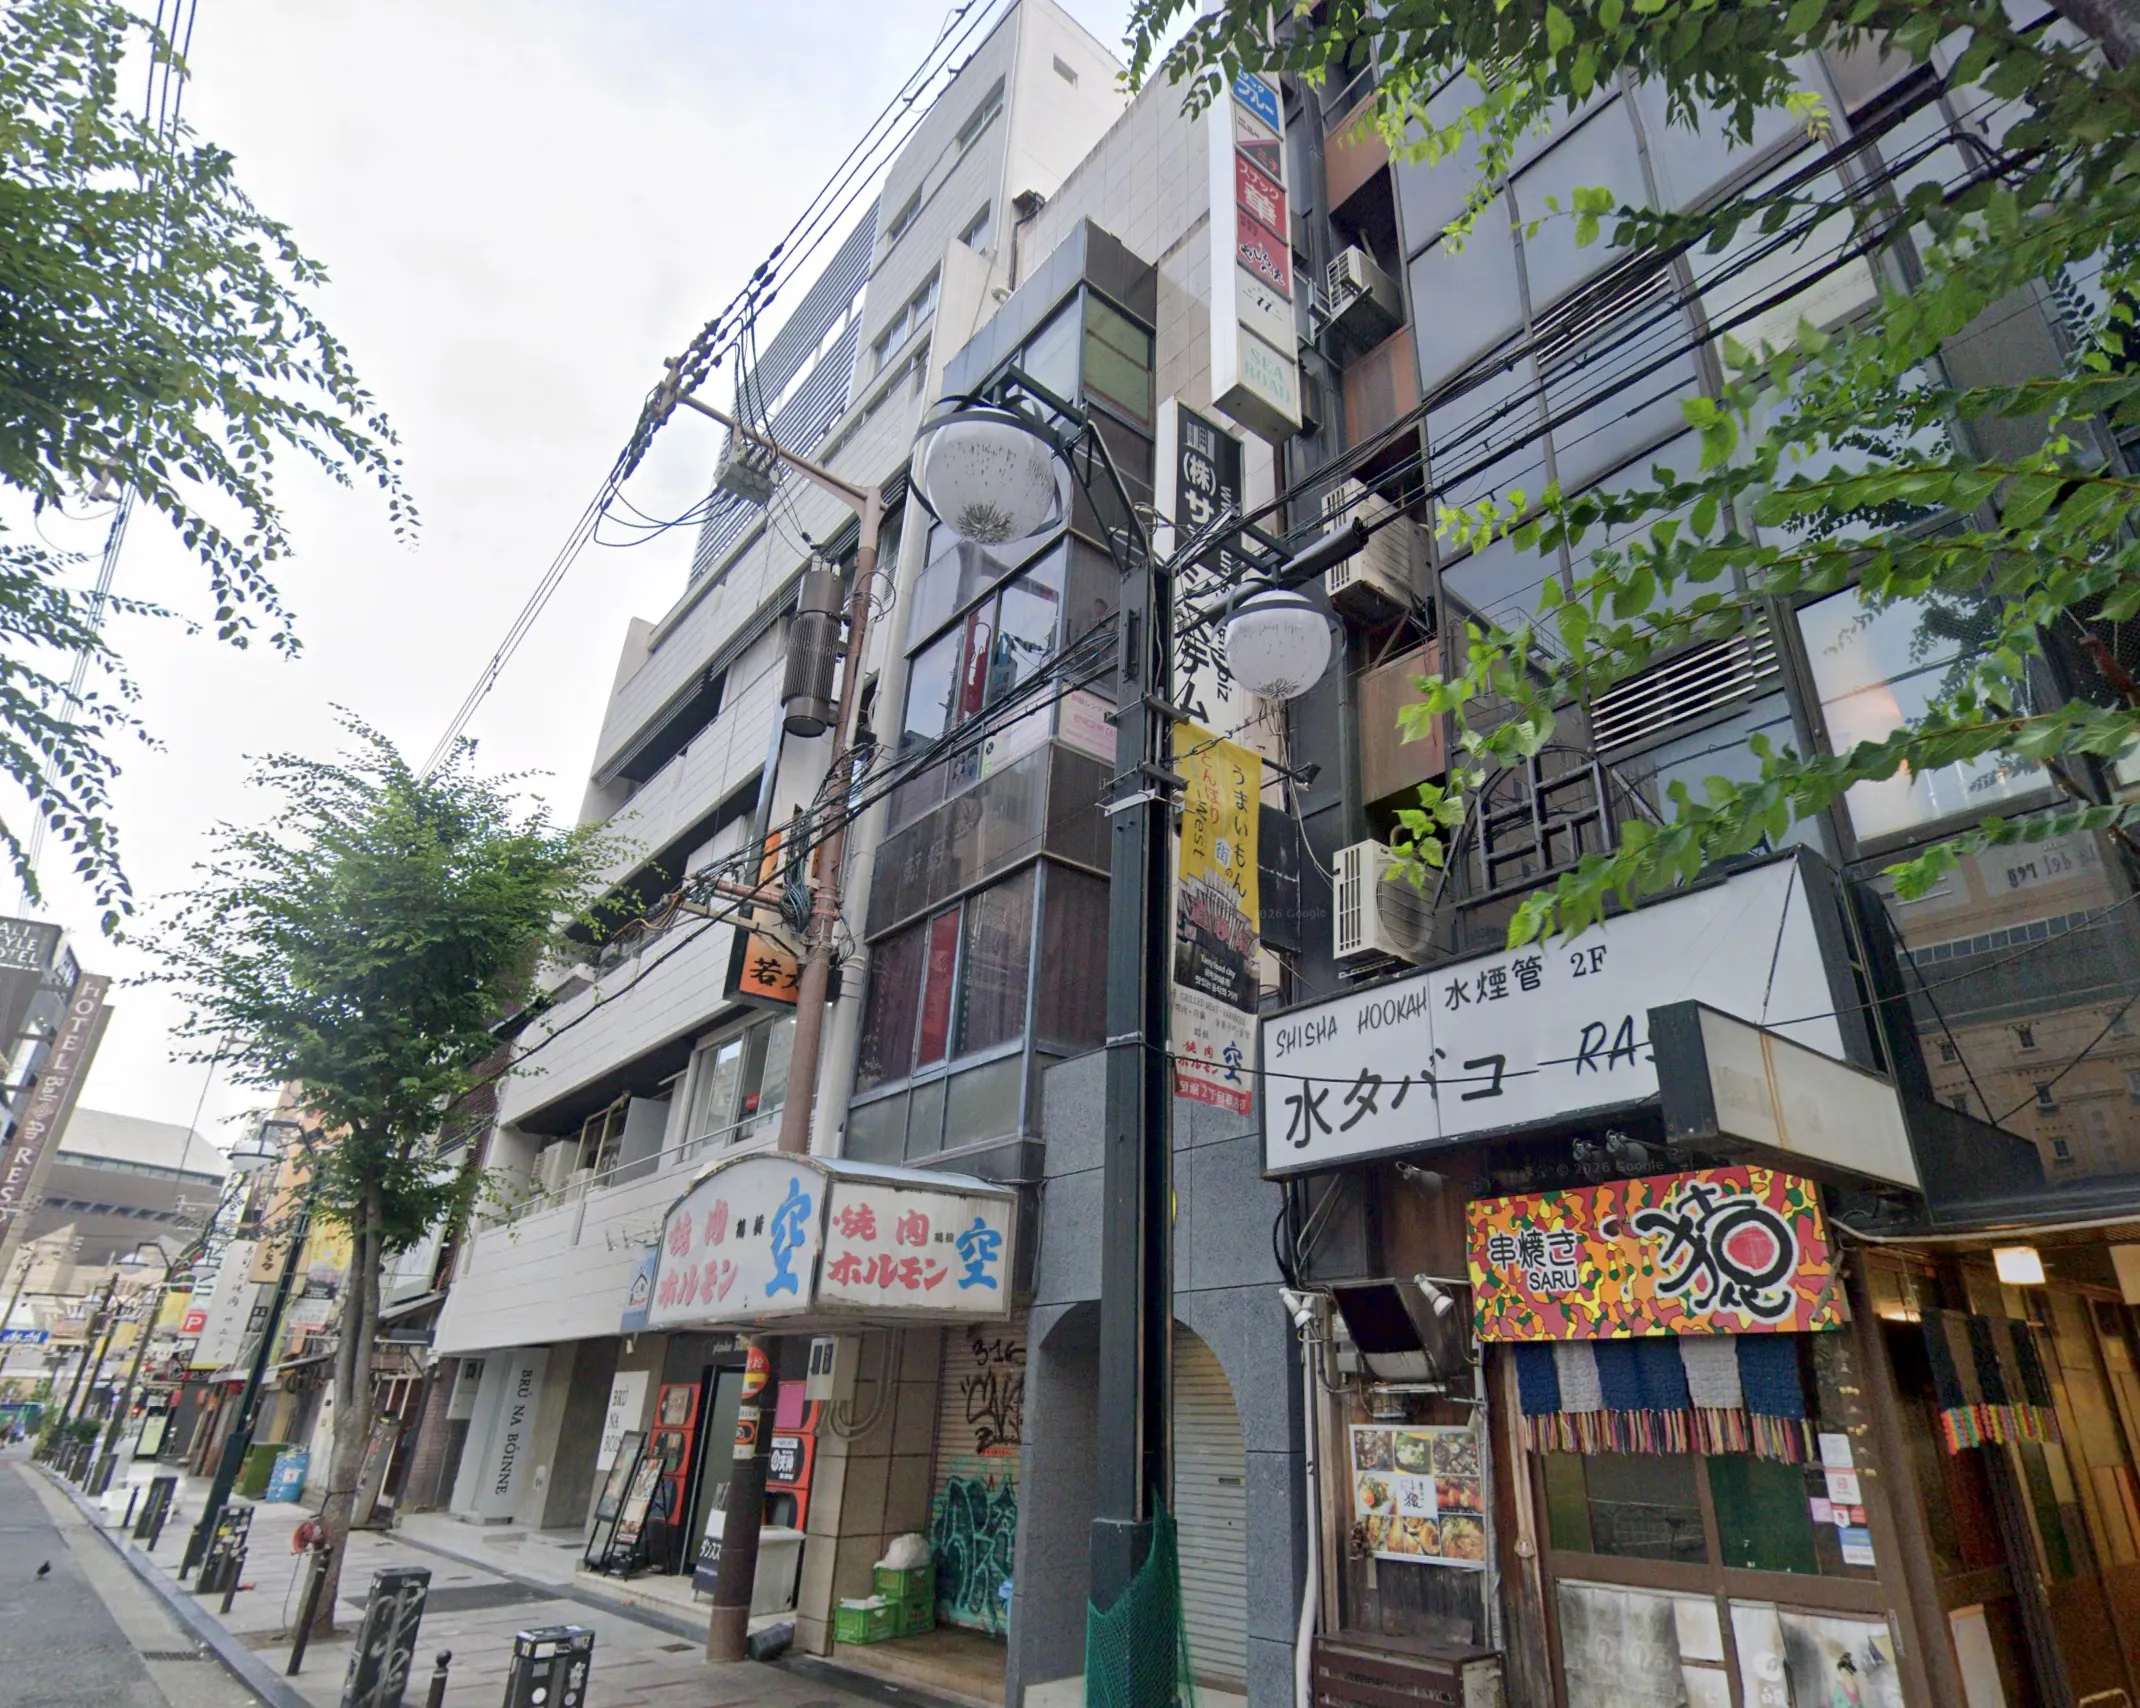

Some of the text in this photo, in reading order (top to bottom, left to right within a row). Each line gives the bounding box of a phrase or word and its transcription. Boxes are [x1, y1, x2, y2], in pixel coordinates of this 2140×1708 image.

[1251, 348, 1283, 382] SEA
[1231, 765, 1248, 898] うまいもん
[1444, 956, 1543, 1011] 水煙管
[1571, 945, 1608, 978] 2F
[52, 980, 100, 1070] HOTEL
[1275, 1020, 1338, 1058] SHISHA
[1357, 987, 1428, 1035] HOOKAH
[1222, 1040, 1243, 1085] 空
[1284, 1047, 1507, 1148] 水タバコ
[668, 1198, 729, 1258] 焼肉
[765, 1176, 812, 1298] 空
[832, 1203, 930, 1247] 焼肉
[955, 1217, 1003, 1290] 空
[1488, 1229, 1577, 1270] 串焼き
[658, 1258, 738, 1310] ホルモン
[827, 1251, 948, 1291] ホルモン
[1528, 1268, 1578, 1292] SARU
[186, 1316, 203, 1330] P
[495, 1369, 533, 1495] BRÚ NA BÓINNE
